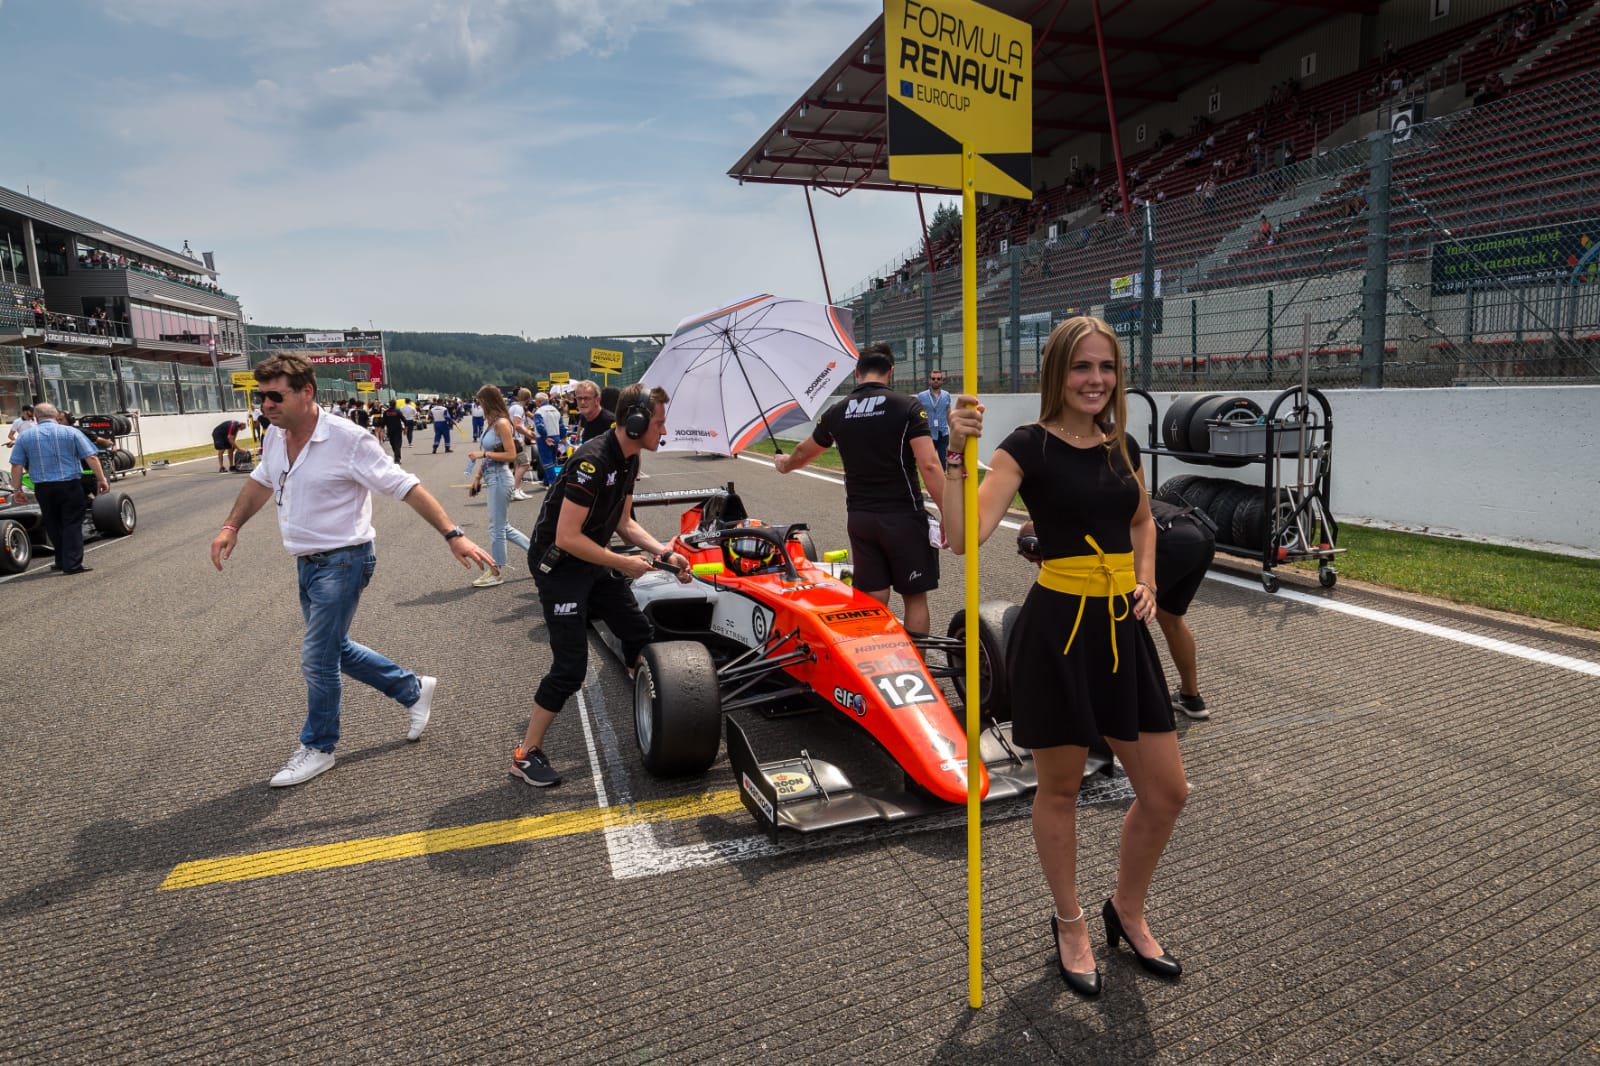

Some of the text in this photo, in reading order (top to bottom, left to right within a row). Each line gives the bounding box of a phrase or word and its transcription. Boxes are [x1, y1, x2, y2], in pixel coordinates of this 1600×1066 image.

[903, 0, 1023, 69] FORMULA
[900, 37, 1024, 102] RENAULT
[917, 84, 971, 112] EUROCUP
[1472, 237, 1529, 252] company
[1484, 251, 1546, 270] racetrack
[1551, 250, 1559, 262] ?
[329, 356, 354, 364] Sport
[845, 395, 887, 414] MP
[665, 488, 717, 497] RENAULT
[554, 602, 578, 613] MP
[825, 609, 880, 621] FOMET
[834, 687, 854, 708] elf
[878, 674, 935, 705] 12
[774, 778, 804, 788] ROON
[778, 785, 796, 794] OIL
